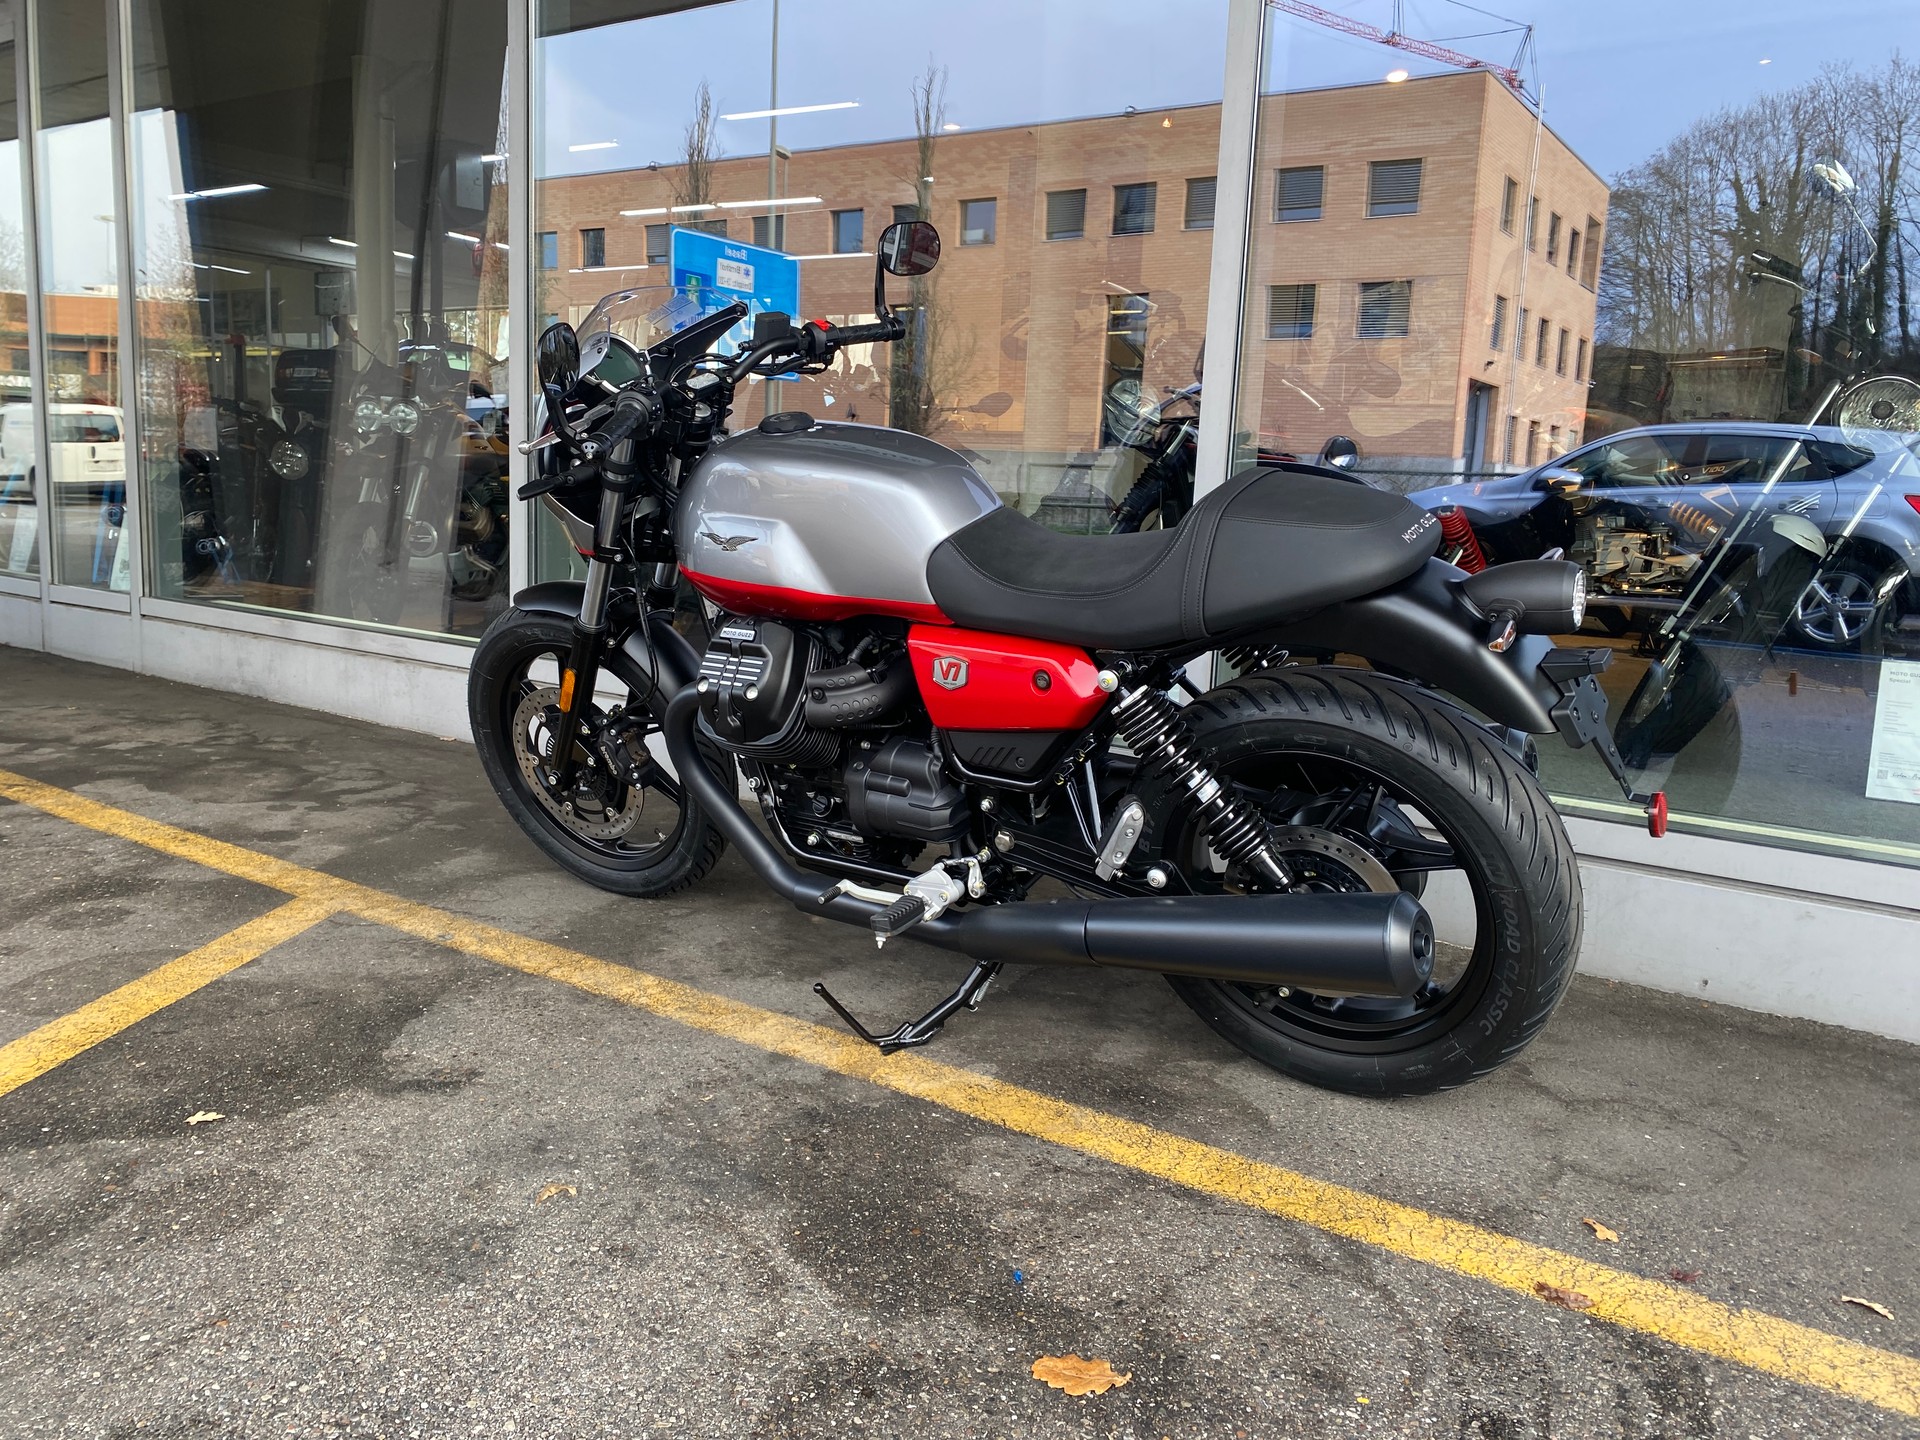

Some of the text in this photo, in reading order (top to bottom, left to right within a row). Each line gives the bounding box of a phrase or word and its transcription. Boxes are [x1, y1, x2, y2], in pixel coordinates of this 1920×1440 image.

[1702, 465, 1726, 474] V100
[1401, 523, 1424, 544] MOTO
[938, 660, 961, 682] V7
[600, 745, 618, 775] brembo
[1478, 891, 1521, 1036] ROAD CLASSIC
